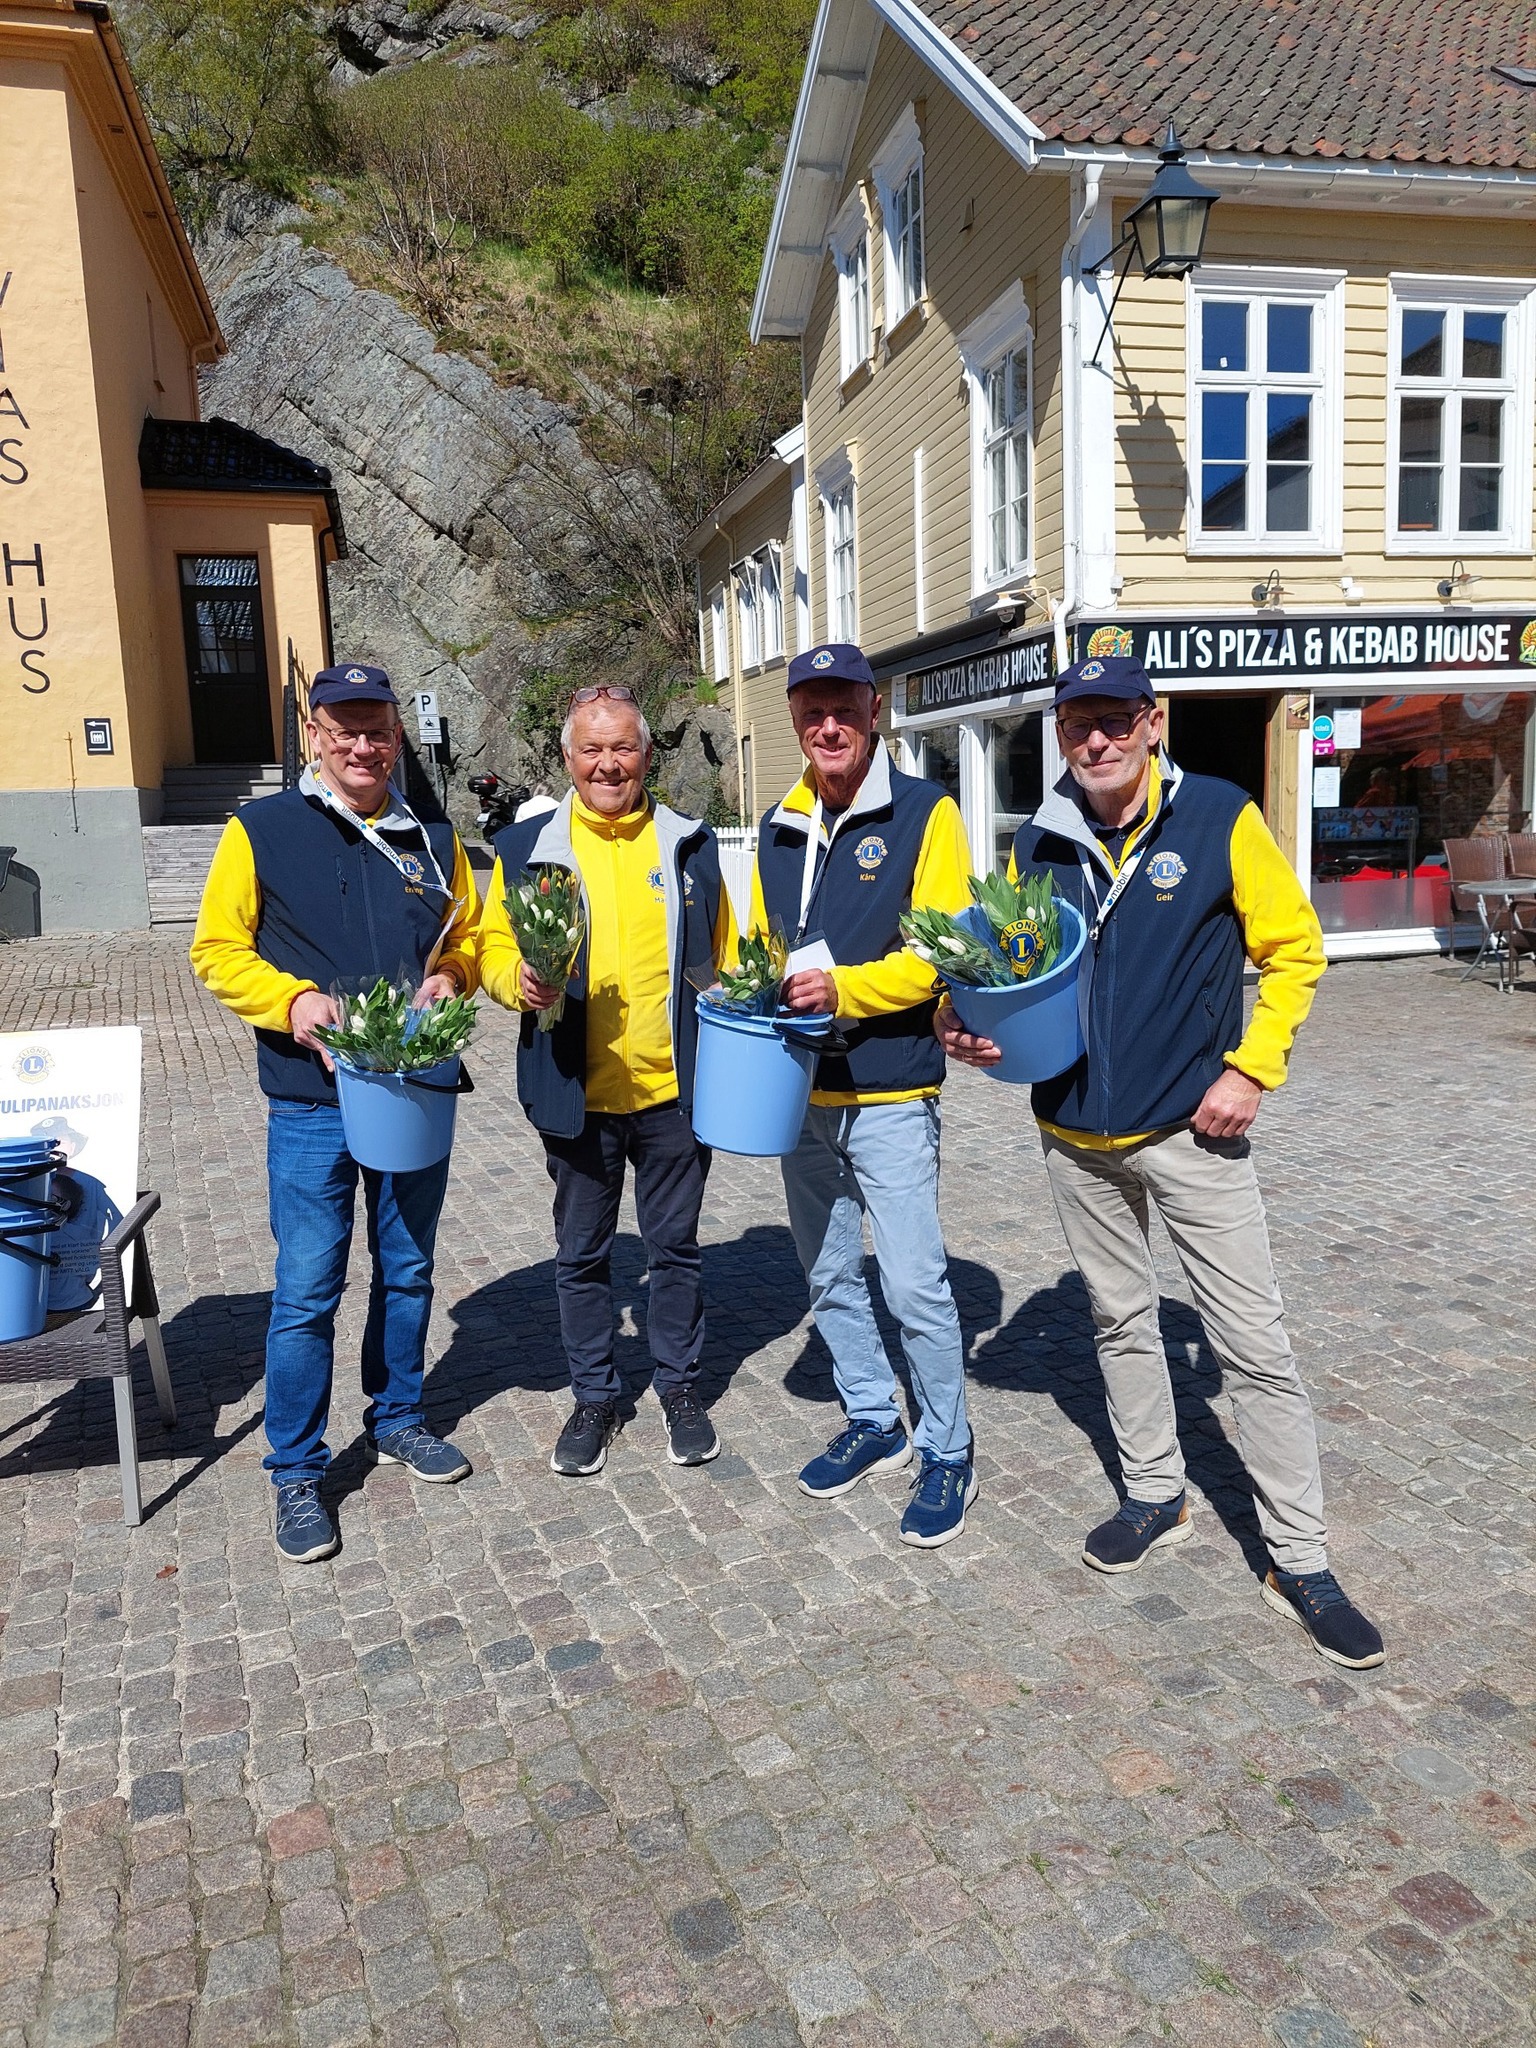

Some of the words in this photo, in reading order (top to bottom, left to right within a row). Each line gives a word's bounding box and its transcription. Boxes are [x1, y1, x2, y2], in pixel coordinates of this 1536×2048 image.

[2, 543, 51, 694] HUS
[1219, 628, 1298, 668] PIZZA
[1304, 627, 1323, 666] &
[1330, 625, 1418, 665] KEBAB
[1425, 624, 1511, 663] HOUSE
[943, 666, 967, 702] PIZZA
[968, 663, 975, 695] &
[976, 654, 1009, 693] KEBAB
[1011, 642, 1048, 686] HOUSE
[421, 695, 431, 711] P
[376, 838, 398, 860] mobit
[867, 846, 876, 858] L
[1154, 853, 1179, 861] LIONS
[1162, 863, 1173, 876] L
[1111, 872, 1130, 900] mobit
[1156, 893, 1174, 901] Geir
[1005, 921, 1036, 935] LIONS
[1017, 937, 1030, 958] L
[22, 1048, 47, 1057] LIONS
[28, 1058, 42, 1072] L
[0, 1092, 124, 1114] ULIPANAKSJON
